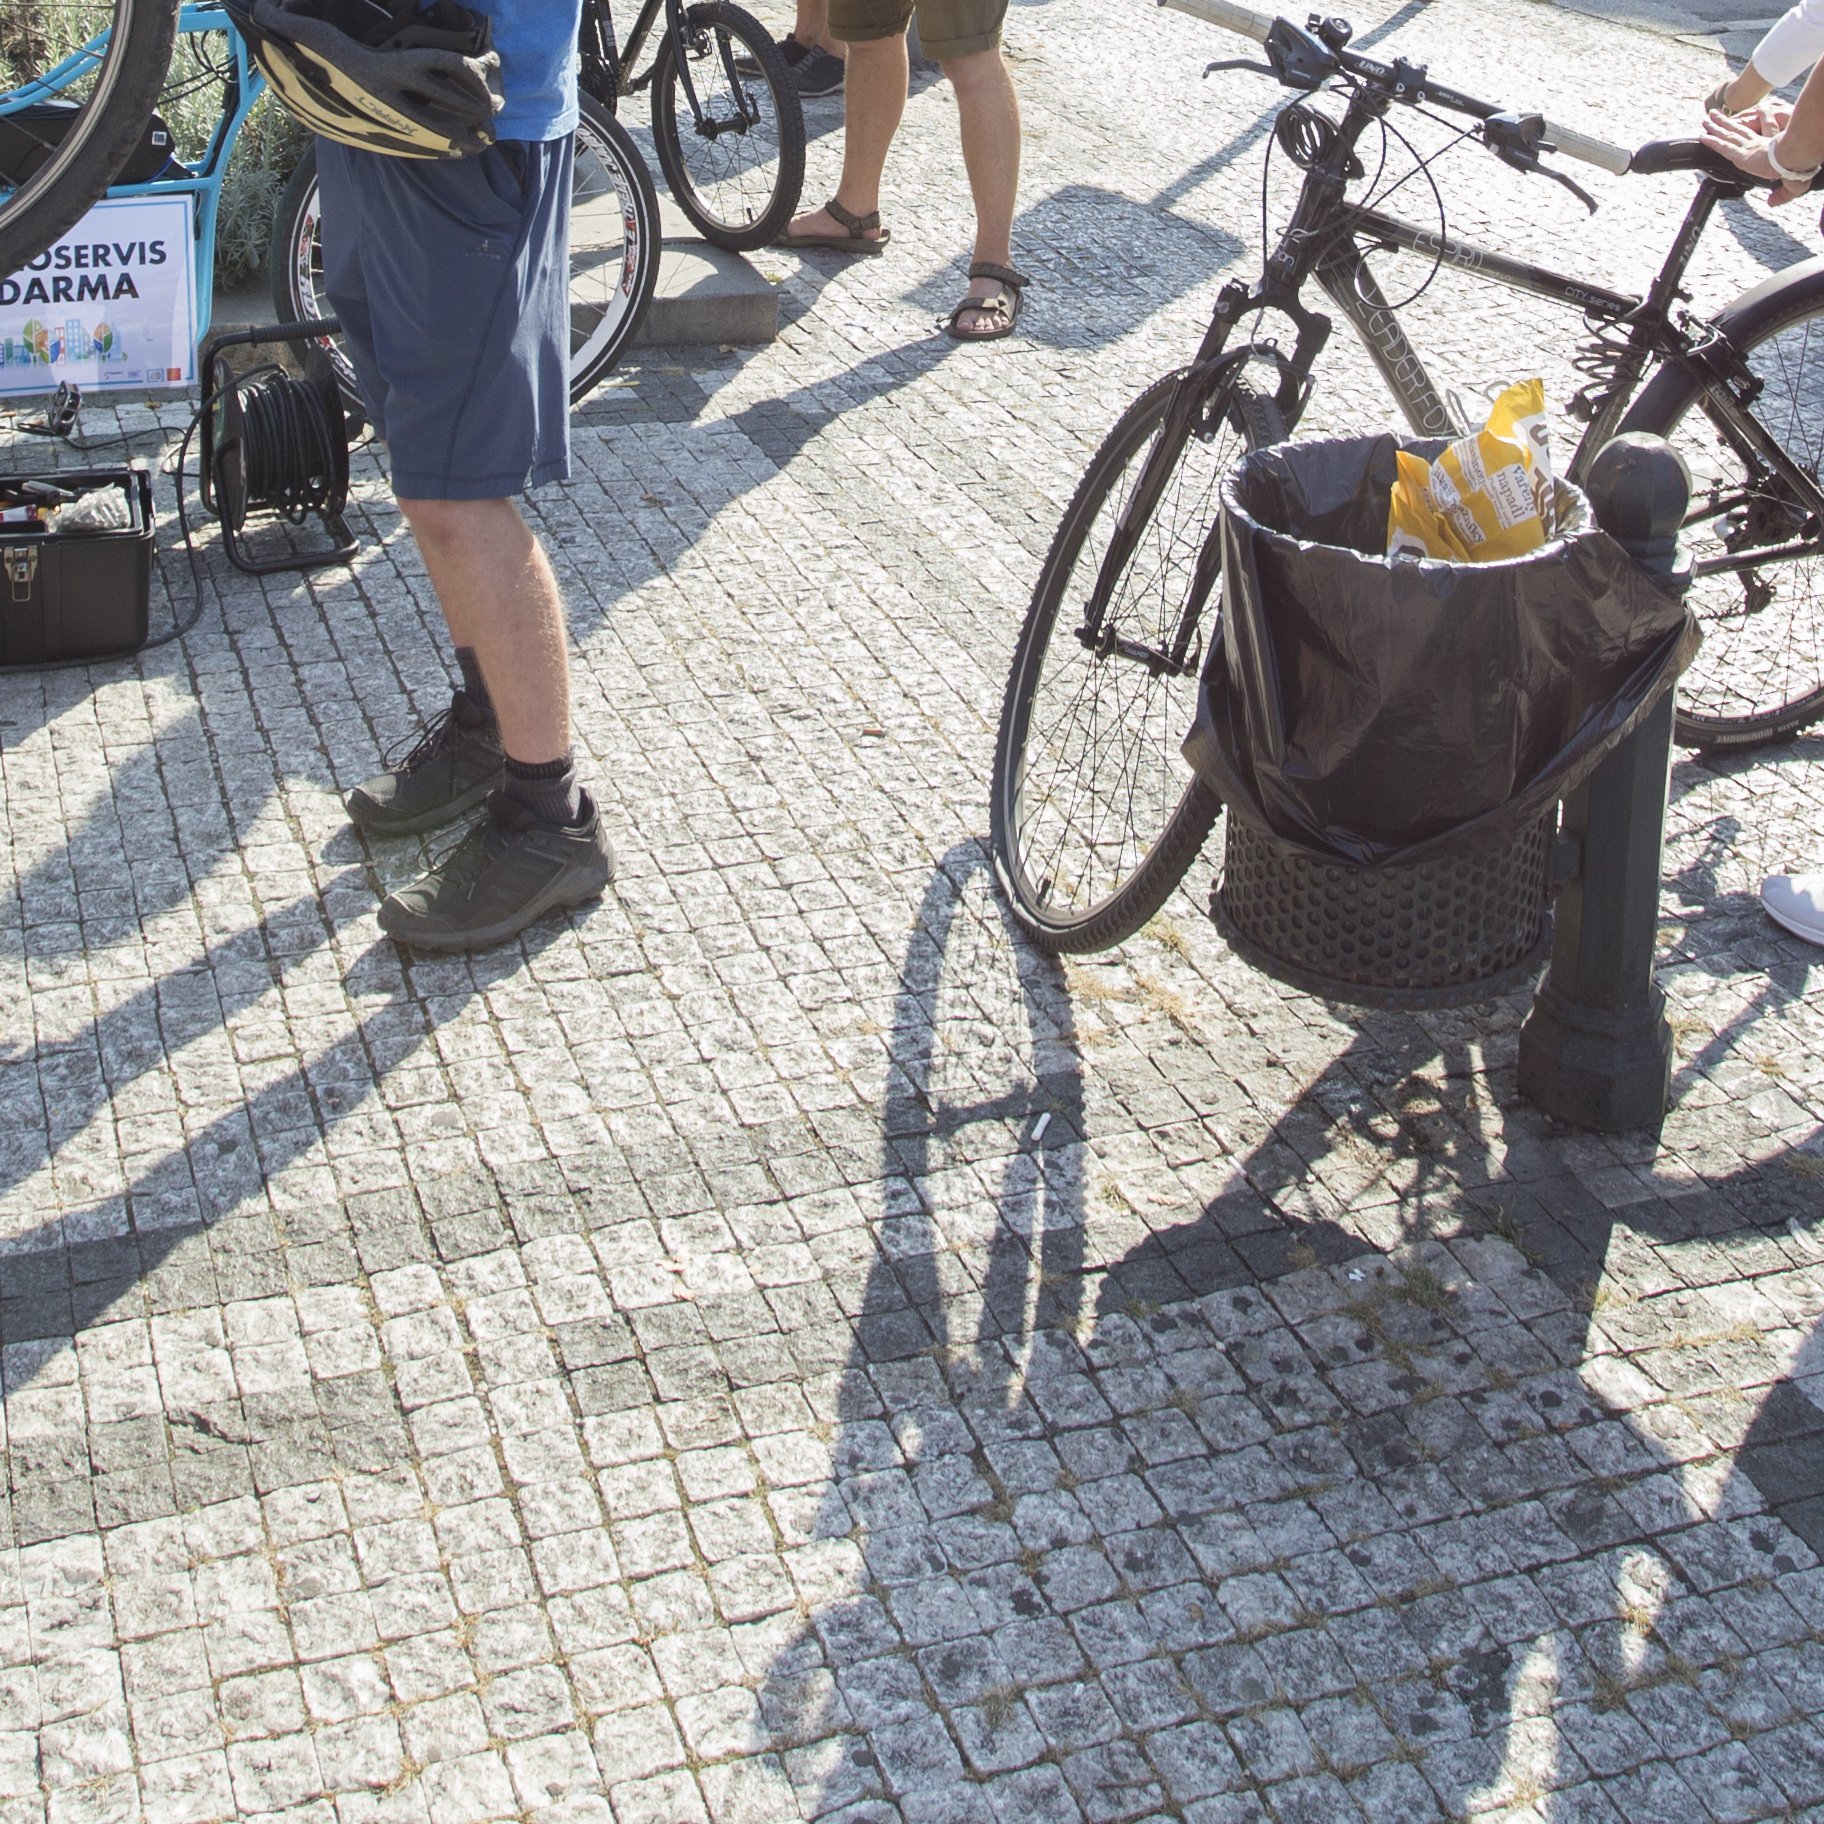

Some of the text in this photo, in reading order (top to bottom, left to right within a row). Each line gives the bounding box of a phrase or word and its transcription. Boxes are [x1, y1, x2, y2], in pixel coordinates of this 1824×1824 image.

[1412, 230, 1488, 270] ESPRIT
[1564, 285, 1622, 312] CITY series
